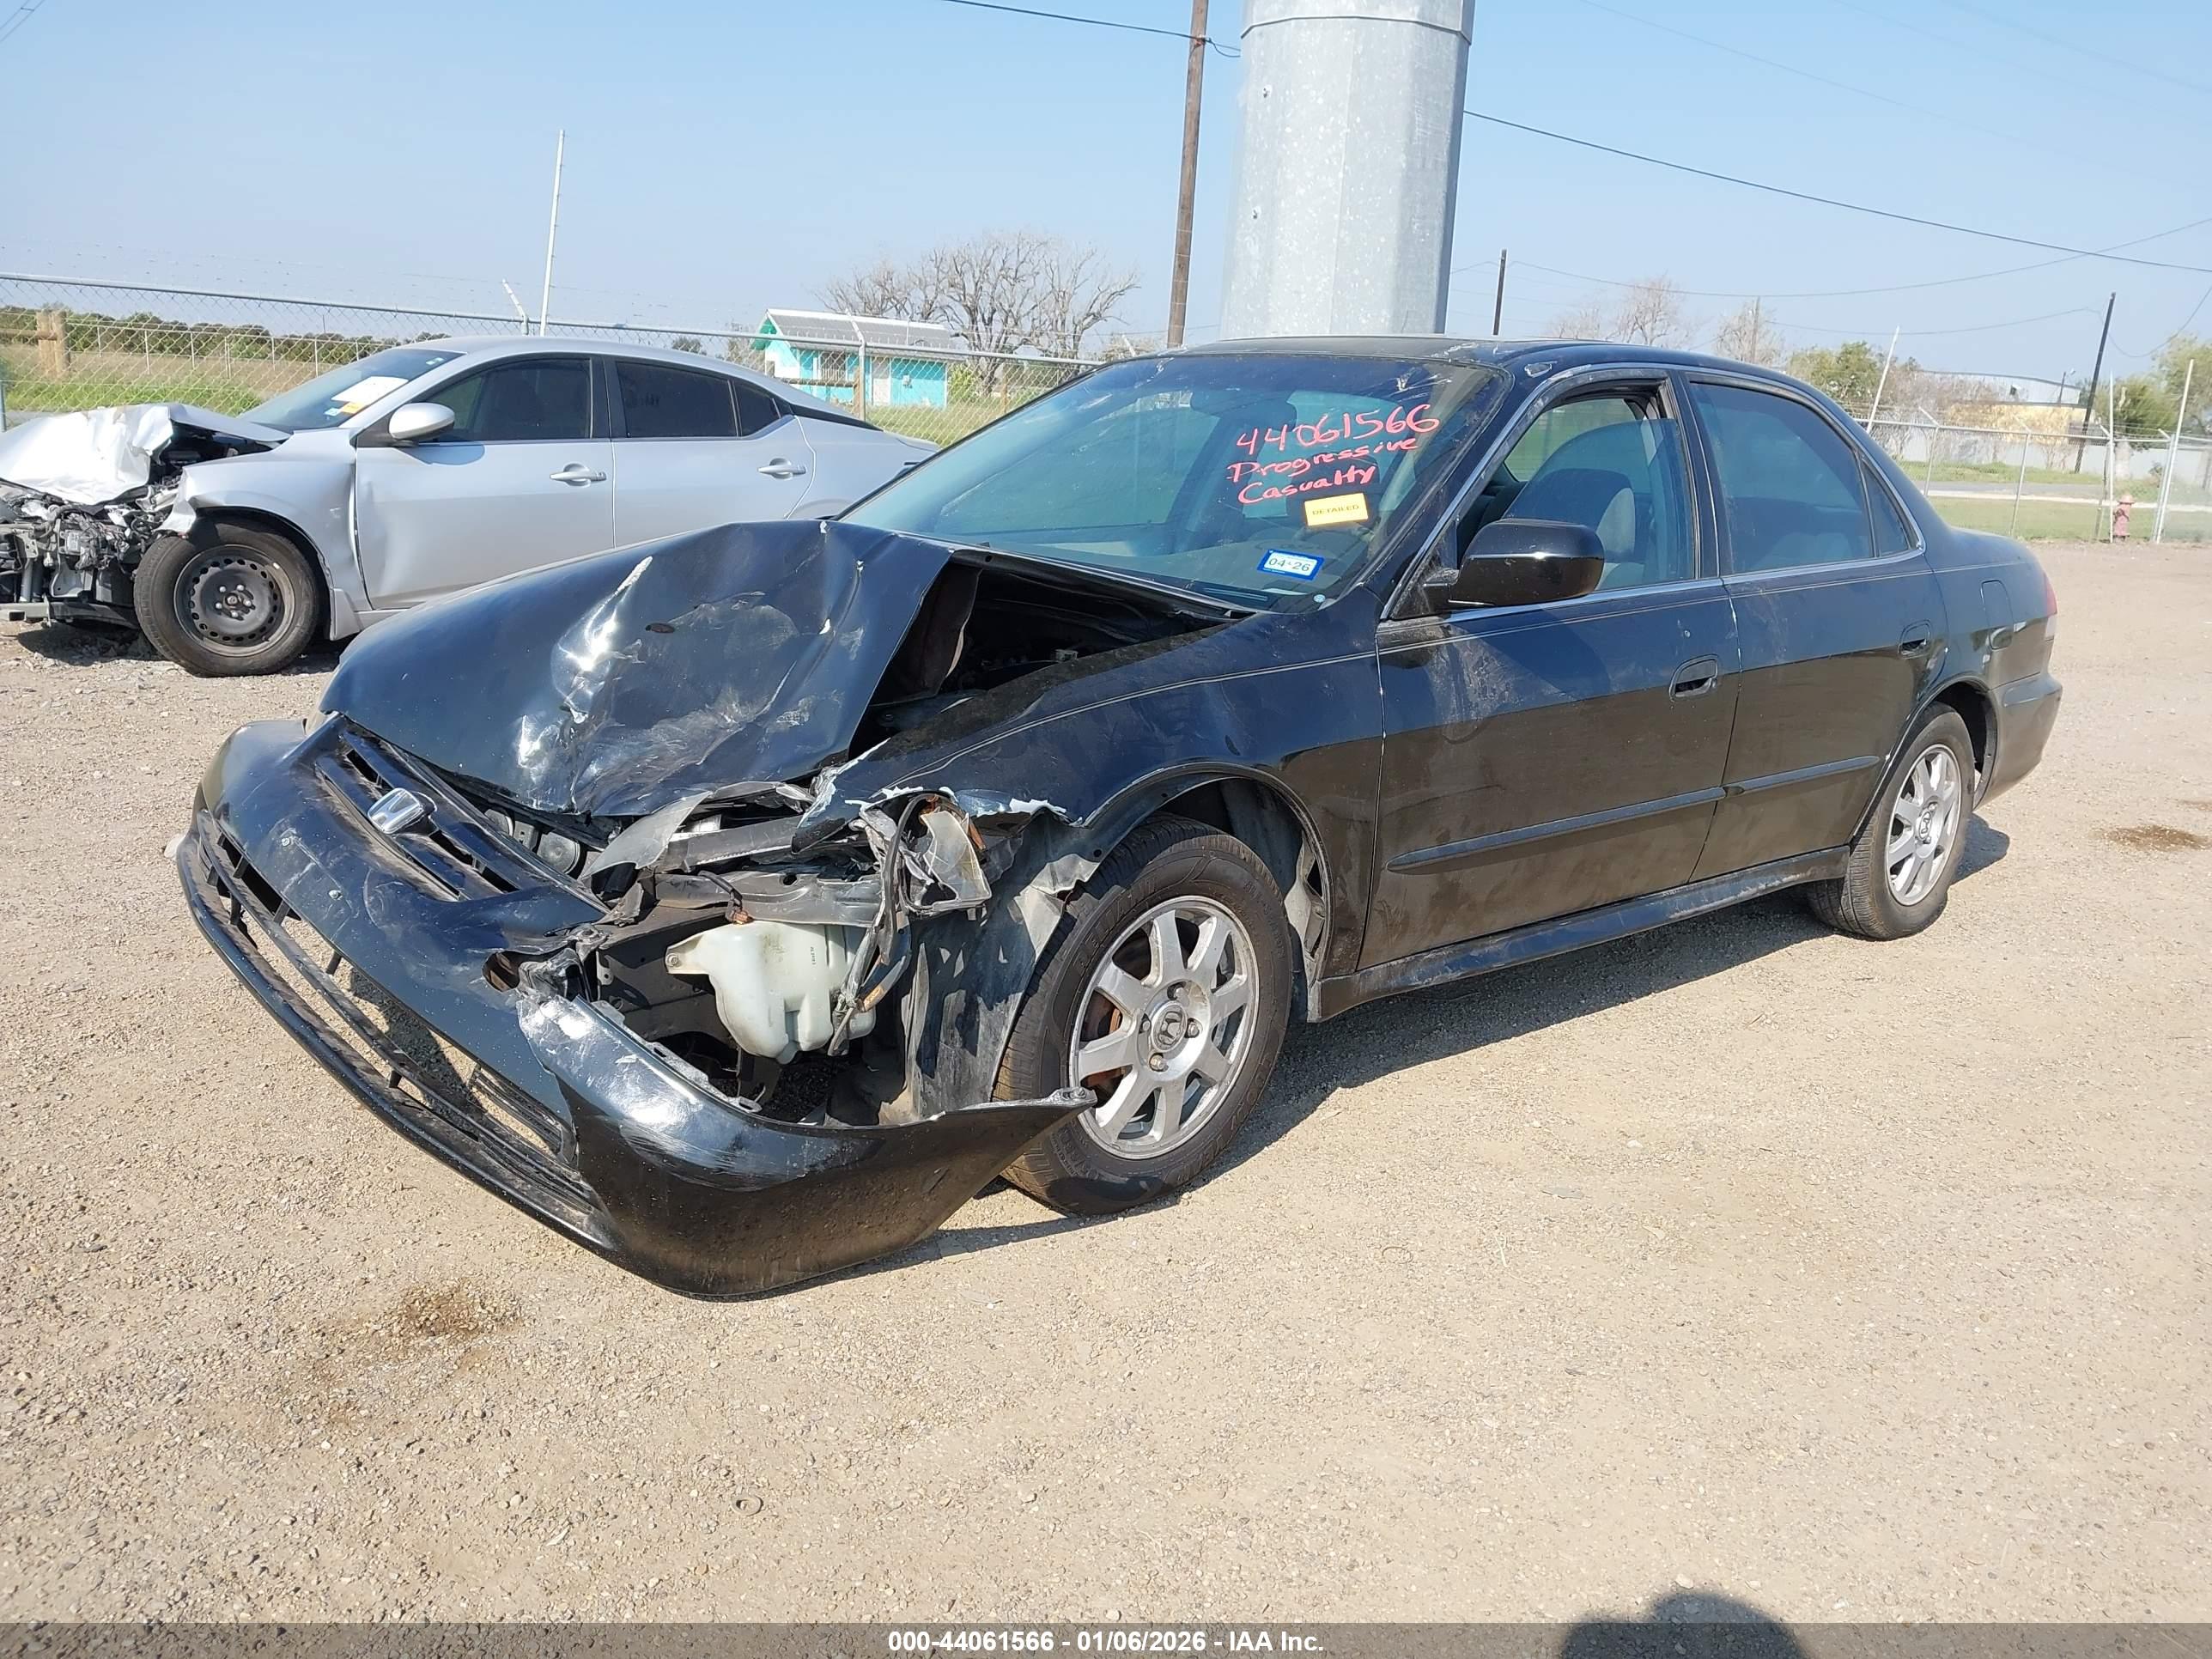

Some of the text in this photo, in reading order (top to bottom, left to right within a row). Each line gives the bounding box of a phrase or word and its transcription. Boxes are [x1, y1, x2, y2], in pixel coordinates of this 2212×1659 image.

[1237, 404, 1440, 455] 44061566
[1226, 437, 1418, 483] Progressive
[1237, 465, 1376, 504] Casualty
